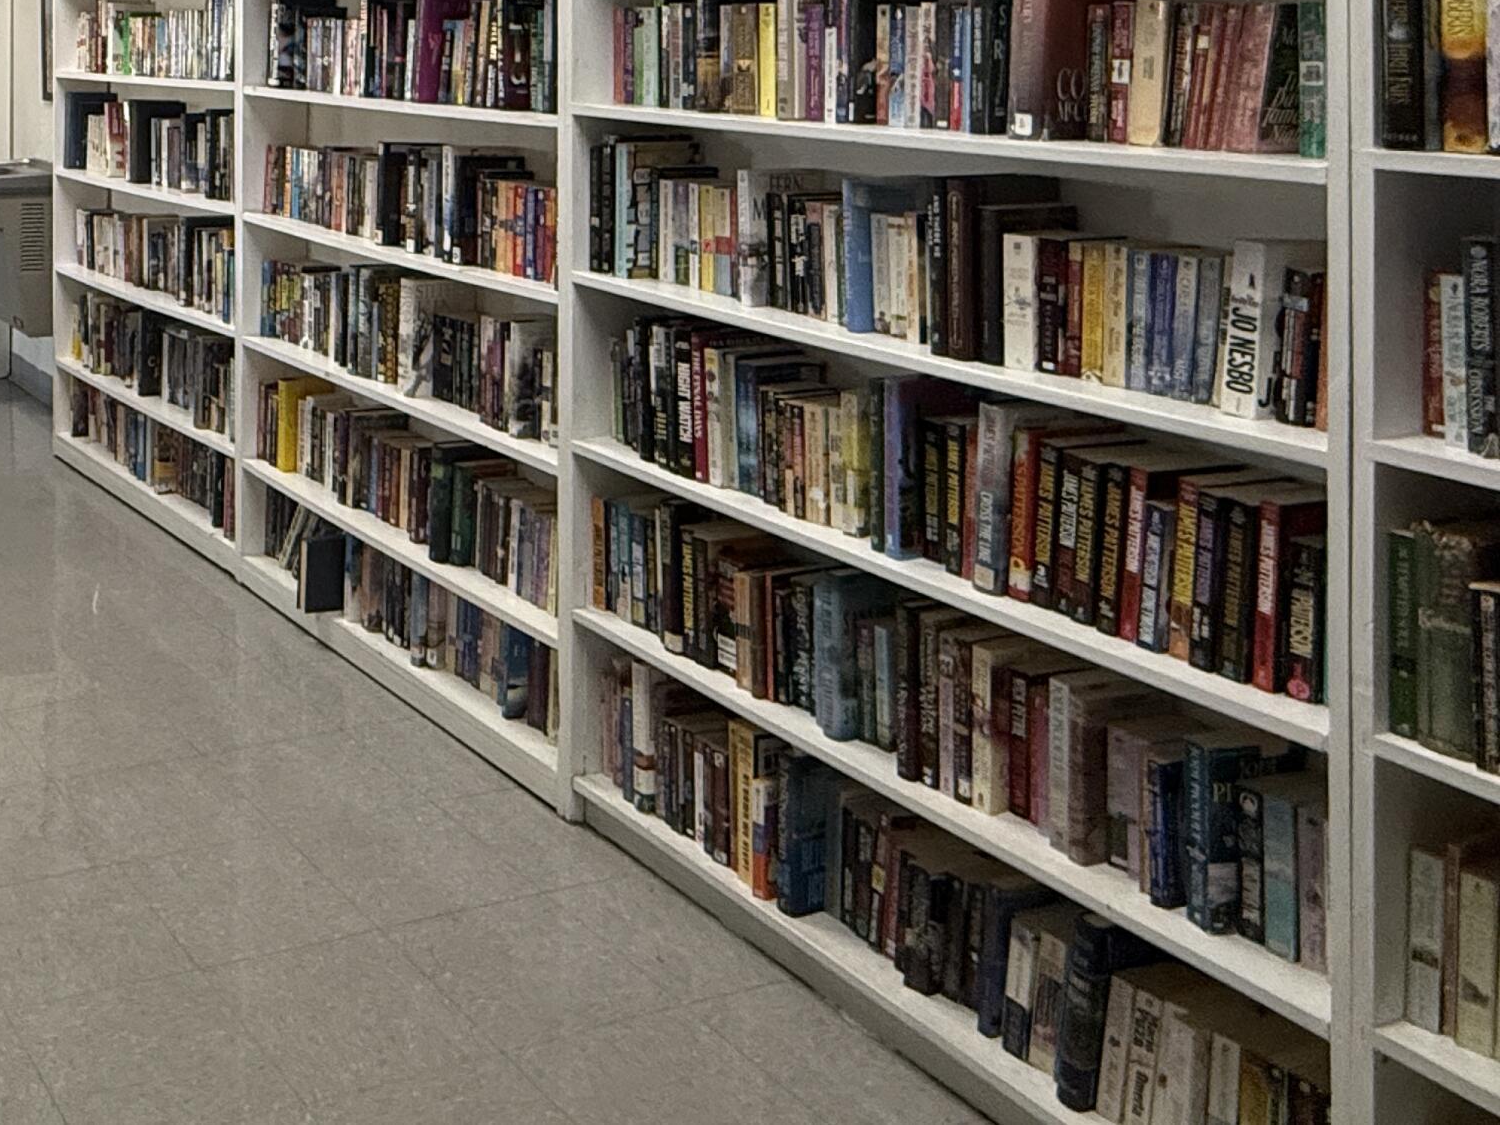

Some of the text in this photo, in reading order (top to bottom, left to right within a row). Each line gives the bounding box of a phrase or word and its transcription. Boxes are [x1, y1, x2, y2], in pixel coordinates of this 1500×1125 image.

[1388, 42, 1413, 77] THREE
[933, 194, 941, 213] AND
[933, 216, 941, 243] THERE
[1469, 259, 1491, 352] NORA ROBERTS
[1225, 307, 1258, 395] JO NESBO
[677, 362, 693, 443] NIGHT WATCH
[693, 350, 703, 438] THE FINAL DAYS
[1468, 368, 1484, 435] OBSESSION
[1484, 395, 1496, 412] THE
[946, 439, 960, 526] JAMES PATTERSON
[979, 491, 993, 522] CROSS
[1011, 475, 1028, 555] PATTERSON
[1034, 461, 1055, 566] JAMES PATTERSON
[1058, 471, 1079, 549] JAMES PATTERSON
[978, 523, 992, 539] THE
[1074, 477, 1097, 584] JAMES PATTERSON
[1099, 482, 1123, 601] JAMES PATTERSON
[1125, 485, 1145, 573] JAMES PATTERSON
[1172, 501, 1198, 606] JAMES PATTERSON
[1194, 514, 1214, 606] JAMES PATTERSON
[1256, 519, 1276, 616] JAMES PATTERSON
[681, 542, 694, 630] JAMES PATTERSON
[1223, 527, 1243, 628] JAMES PATTERSON
[1288, 589, 1314, 659] PATTERSON
[1010, 676, 1028, 740] NICK PETRIE
[1133, 1007, 1149, 1049] Puzo
[1144, 1015, 1160, 1054] Mario
[1131, 1070, 1149, 1118] Omerta
